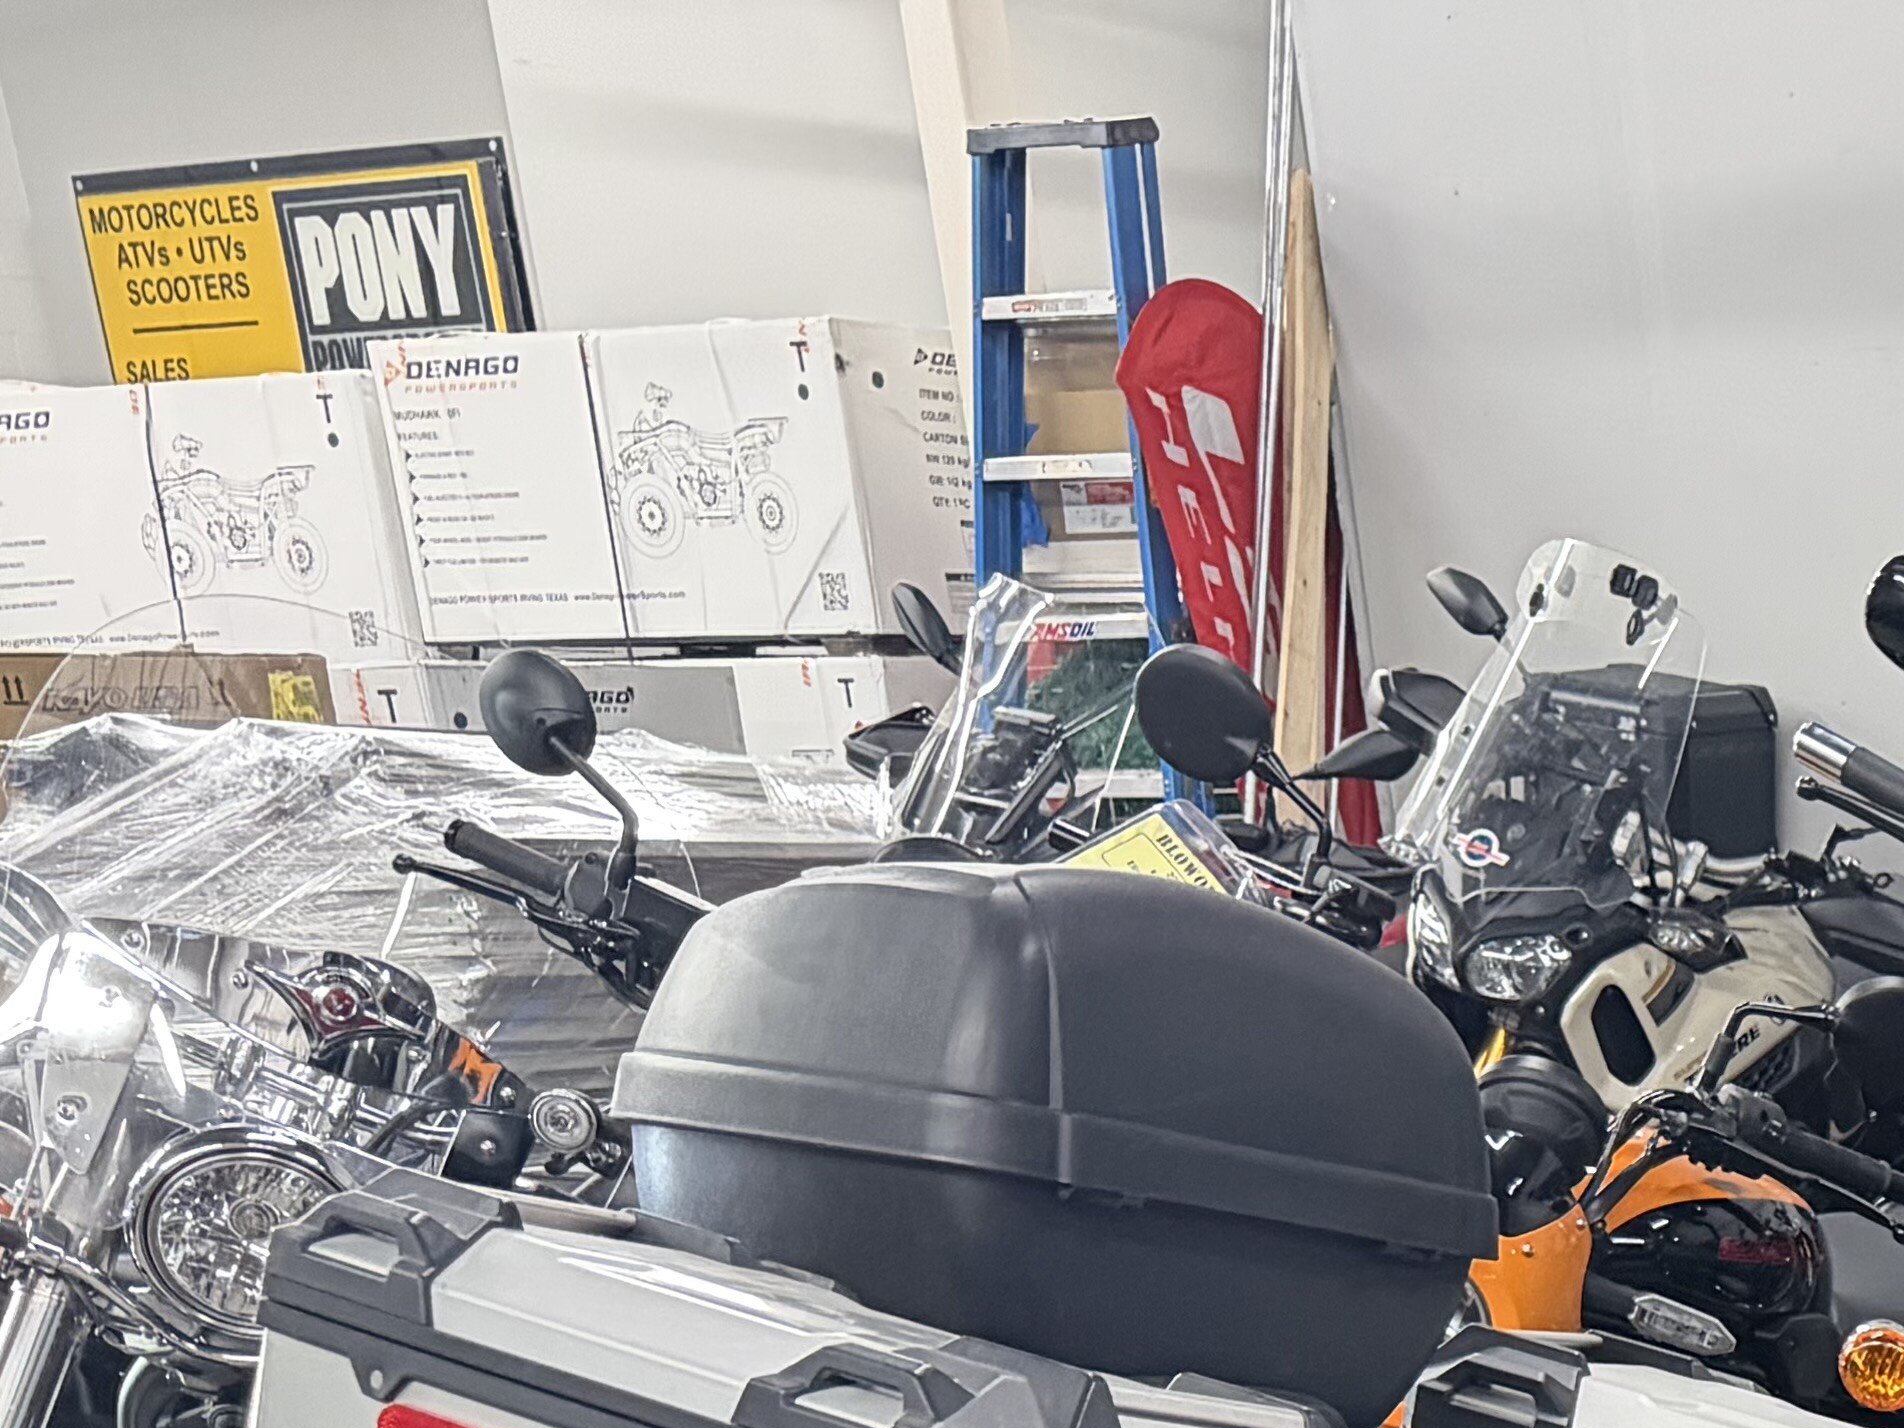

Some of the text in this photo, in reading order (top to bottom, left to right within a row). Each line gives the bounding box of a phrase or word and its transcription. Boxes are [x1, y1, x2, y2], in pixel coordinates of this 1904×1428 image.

[88, 194, 259, 234] MOTORCYCLES
[118, 235, 247, 270] ATVs UTVs
[293, 203, 461, 325] PONY
[126, 272, 250, 306] SCOOTERS
[126, 357, 190, 384] SALES
[406, 356, 519, 380] DENAGO
[1032, 621, 1097, 640] AMSOIL
